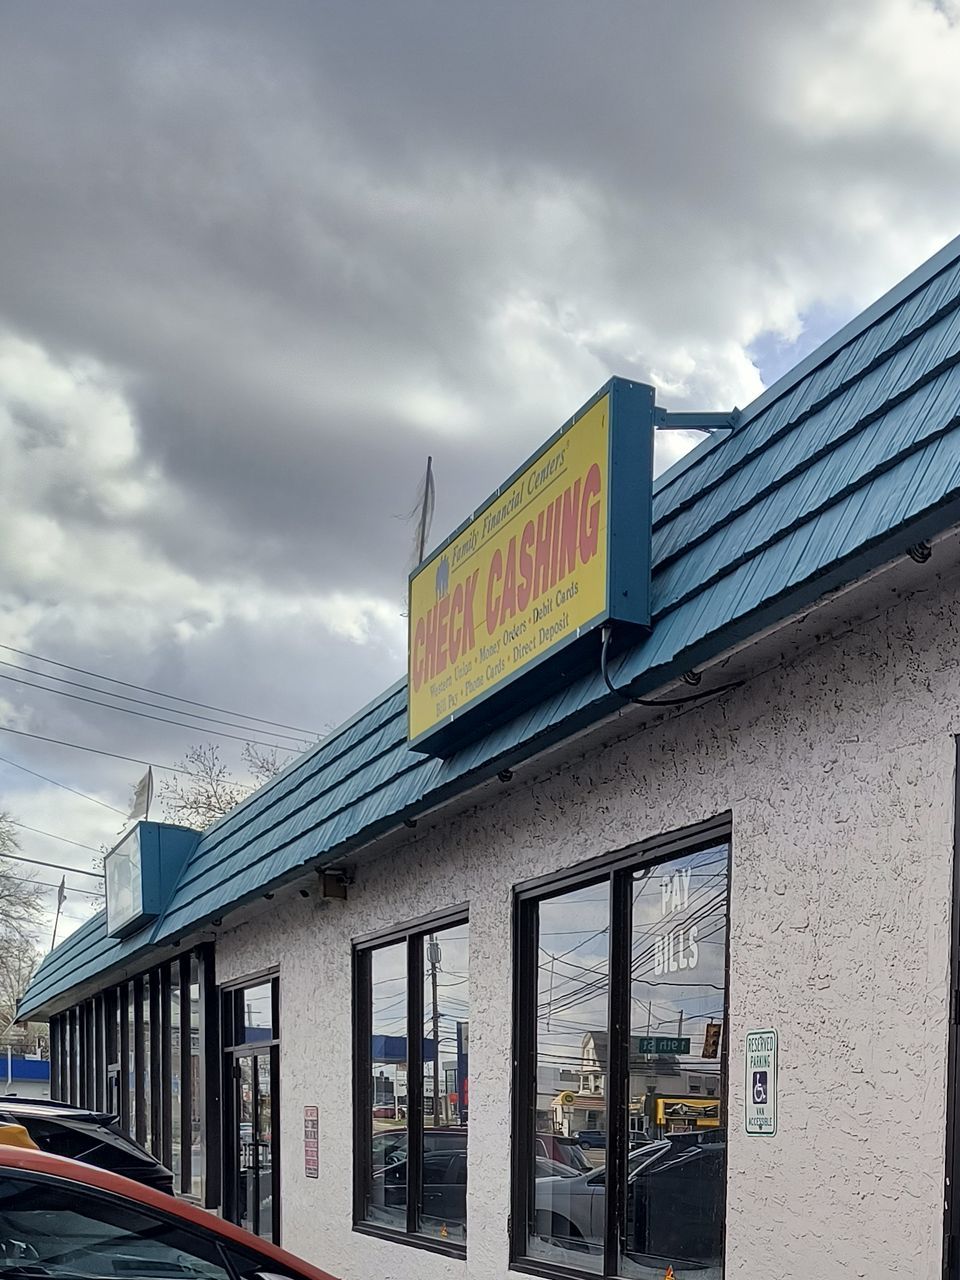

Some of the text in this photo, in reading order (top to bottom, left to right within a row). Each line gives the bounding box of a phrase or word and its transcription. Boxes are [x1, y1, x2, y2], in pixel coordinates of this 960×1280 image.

[451, 449, 565, 567] Family Financial Centers
[412, 463, 602, 693] CHECK CASHING
[479, 638, 501, 664] Money
[502, 620, 527, 646] Orders
[533, 598, 553, 624] Debit
[555, 582, 579, 607] Cards
[486, 657, 505, 680] Cards
[513, 636, 536, 663] Direct
[539, 612, 569, 645] Deposit
[661, 867, 692, 915] PAY
[654, 926, 698, 975] BILLS
[748, 1036, 773, 1053] RESERVED
[750, 1054, 770, 1068] PARKING
